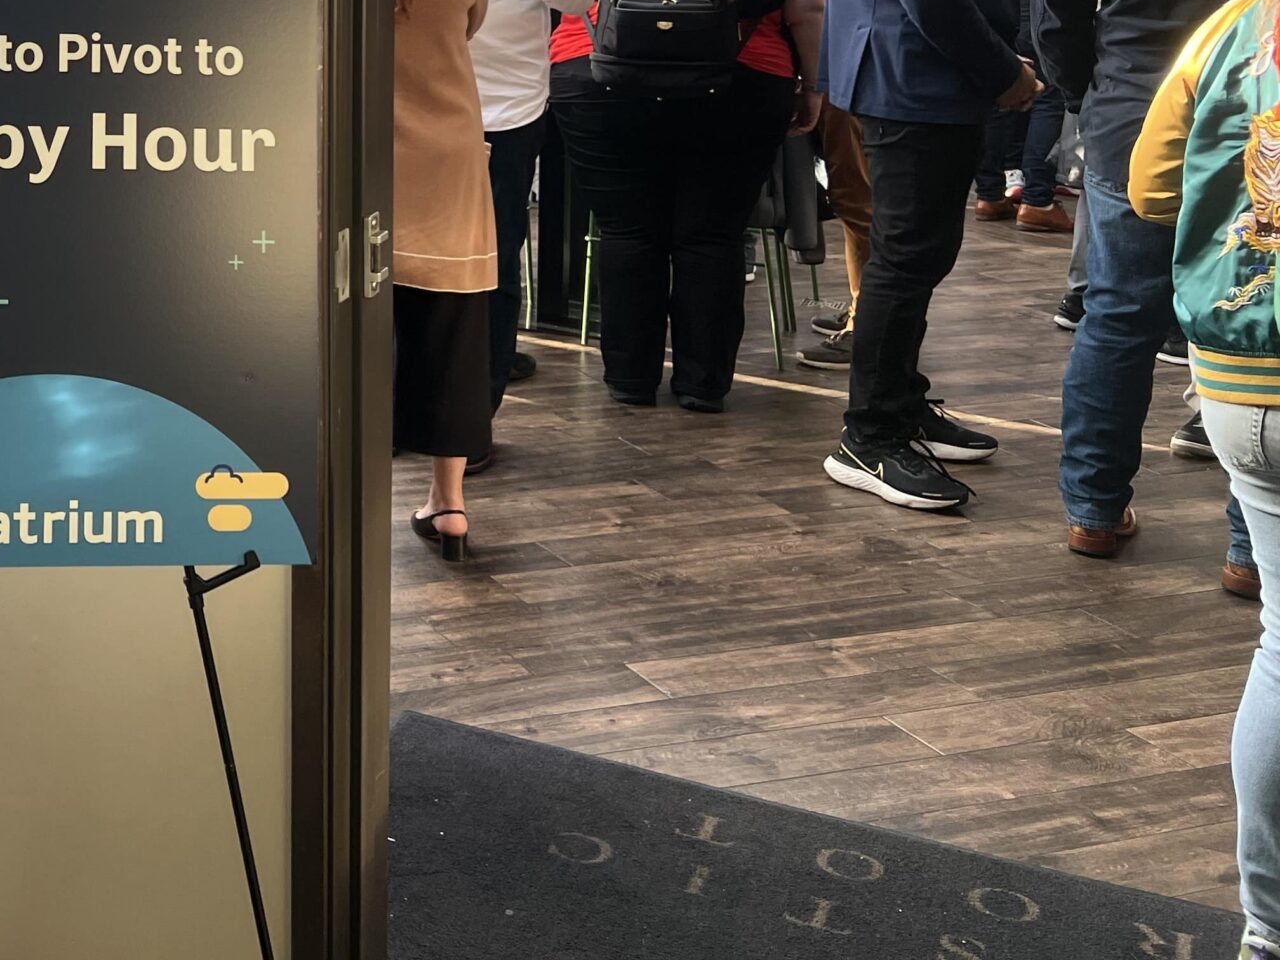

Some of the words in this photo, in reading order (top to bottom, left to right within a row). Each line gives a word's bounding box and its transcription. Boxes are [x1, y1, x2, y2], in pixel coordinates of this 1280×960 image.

[58, 31, 183, 74] Pivot
[195, 38, 245, 76] to
[91, 112, 277, 173] Hour
